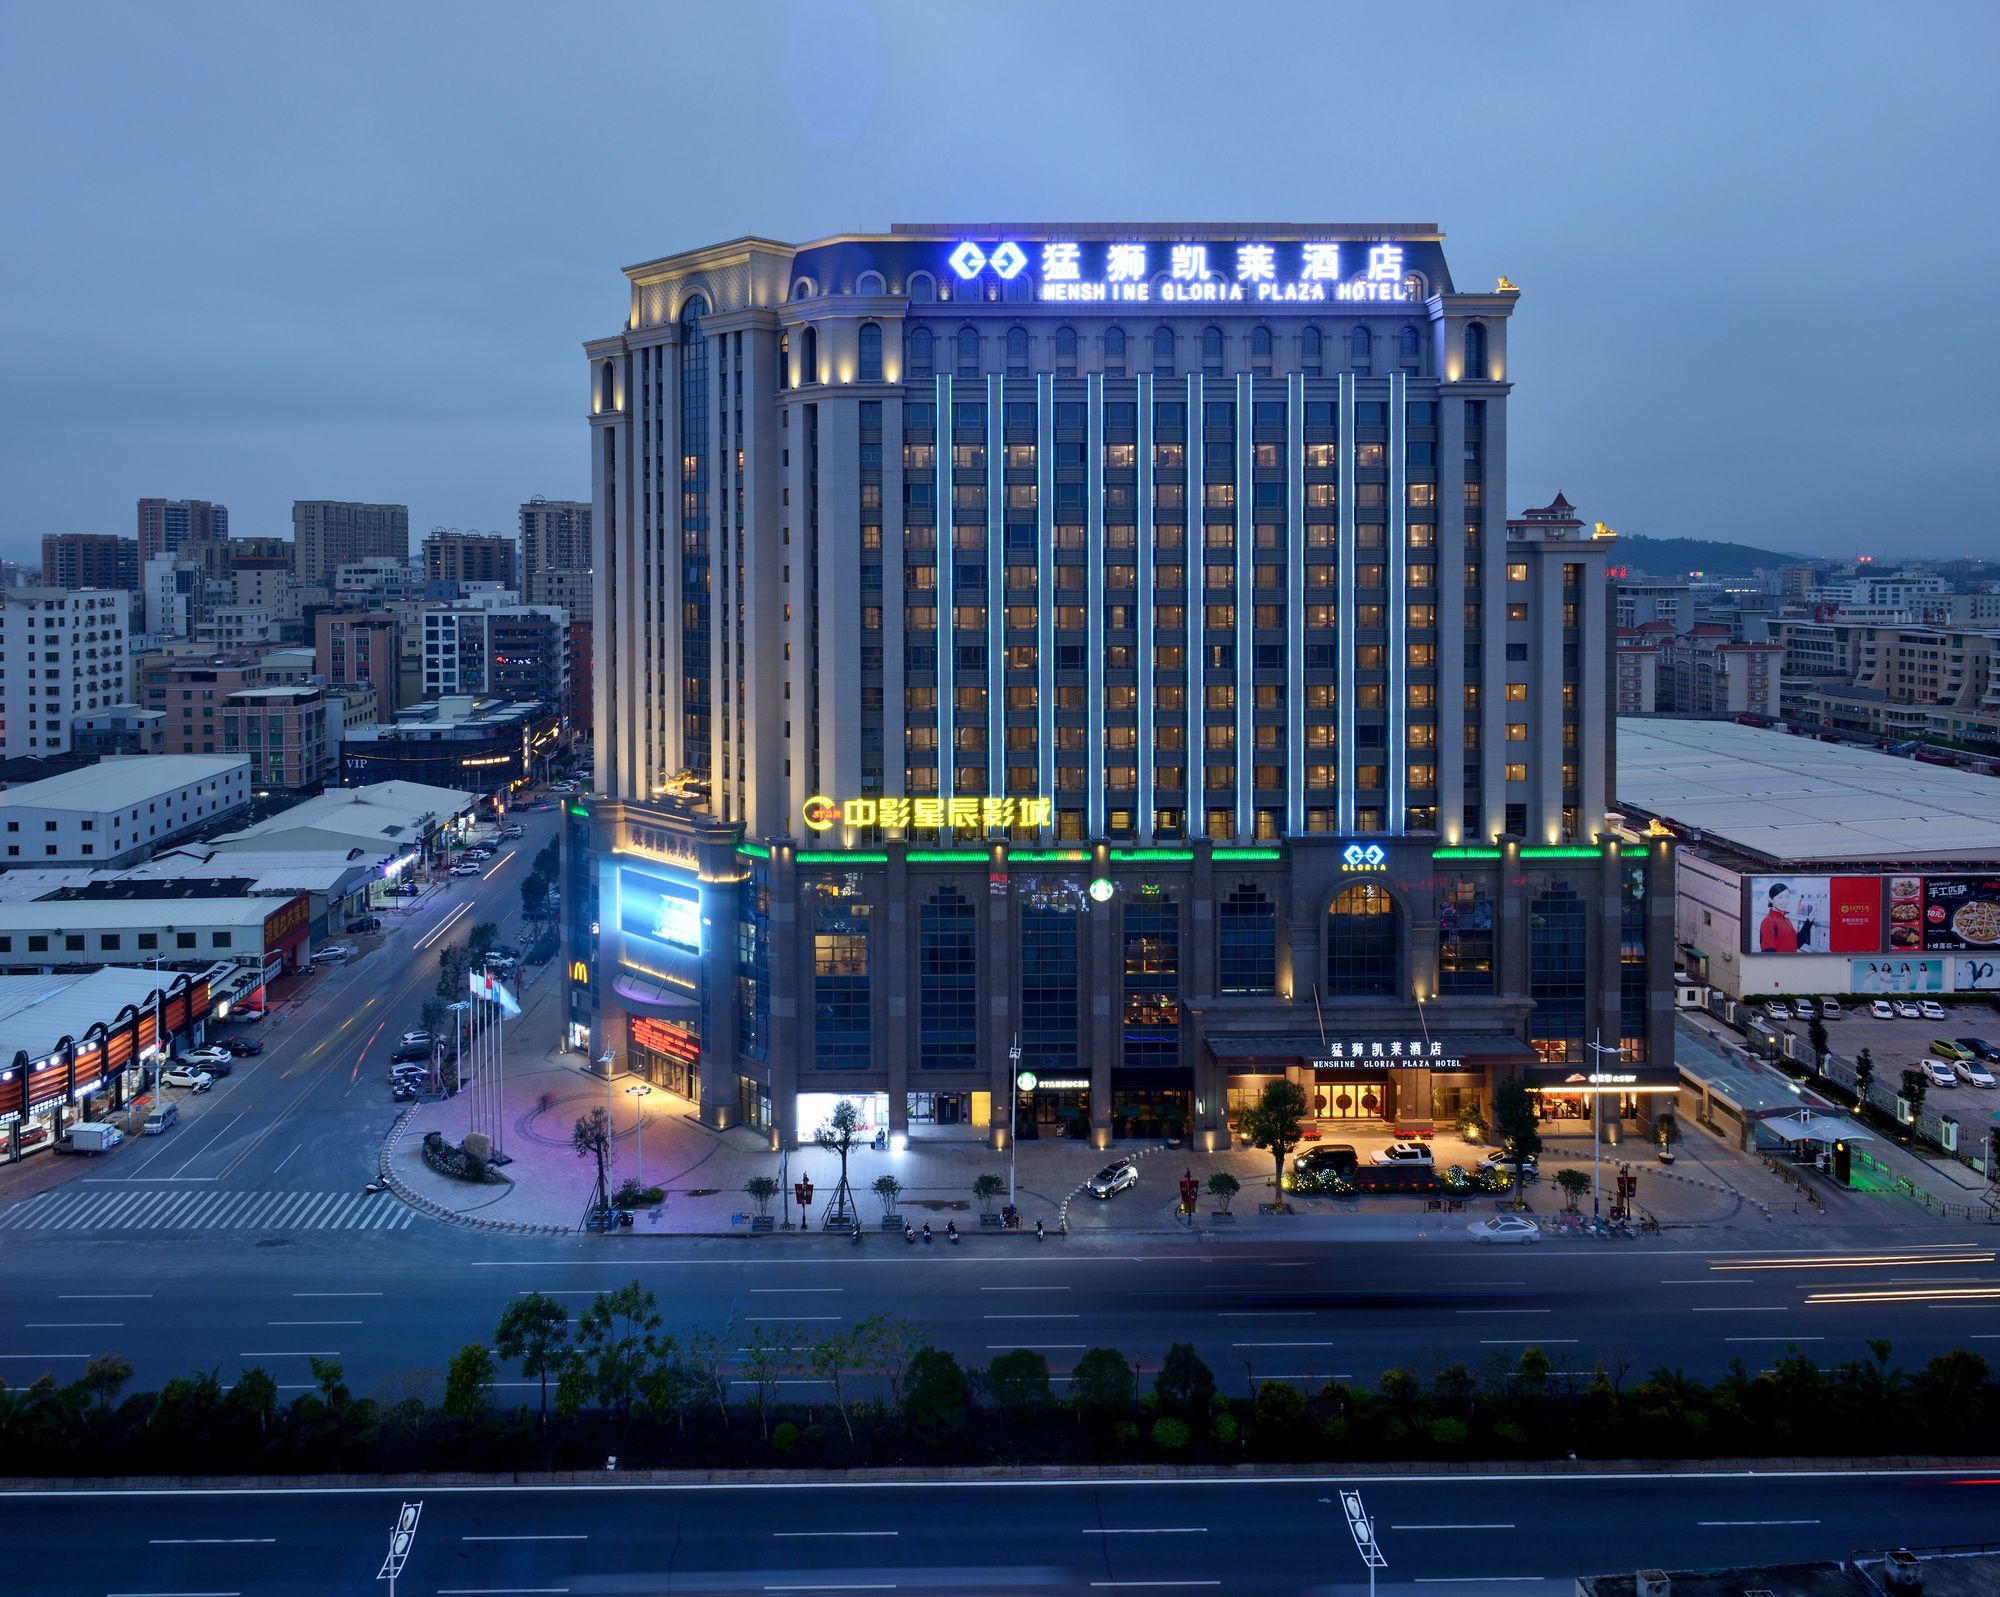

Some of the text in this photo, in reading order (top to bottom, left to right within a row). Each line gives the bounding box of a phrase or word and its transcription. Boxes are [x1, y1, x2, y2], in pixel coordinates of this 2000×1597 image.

[1043, 243, 1402, 281] 猛狮凯莱酒店
[1043, 283, 1408, 301] MENSHINE GLORIA PLAZA HOTEL
[346, 759, 368, 769] VIP
[812, 807, 842, 820] STAR
[844, 797, 1050, 829] 中影星辰影城
[1342, 863, 1387, 872] GLORIA
[1928, 884, 1967, 898] 手工匹萨
[1331, 1041, 1442, 1057] 猛狮凯莱酒店
[1313, 1059, 1462, 1068] MENSHINE GLORIA PLAZA HOTEL
[1038, 1080, 1090, 1089] STARBUCKS
